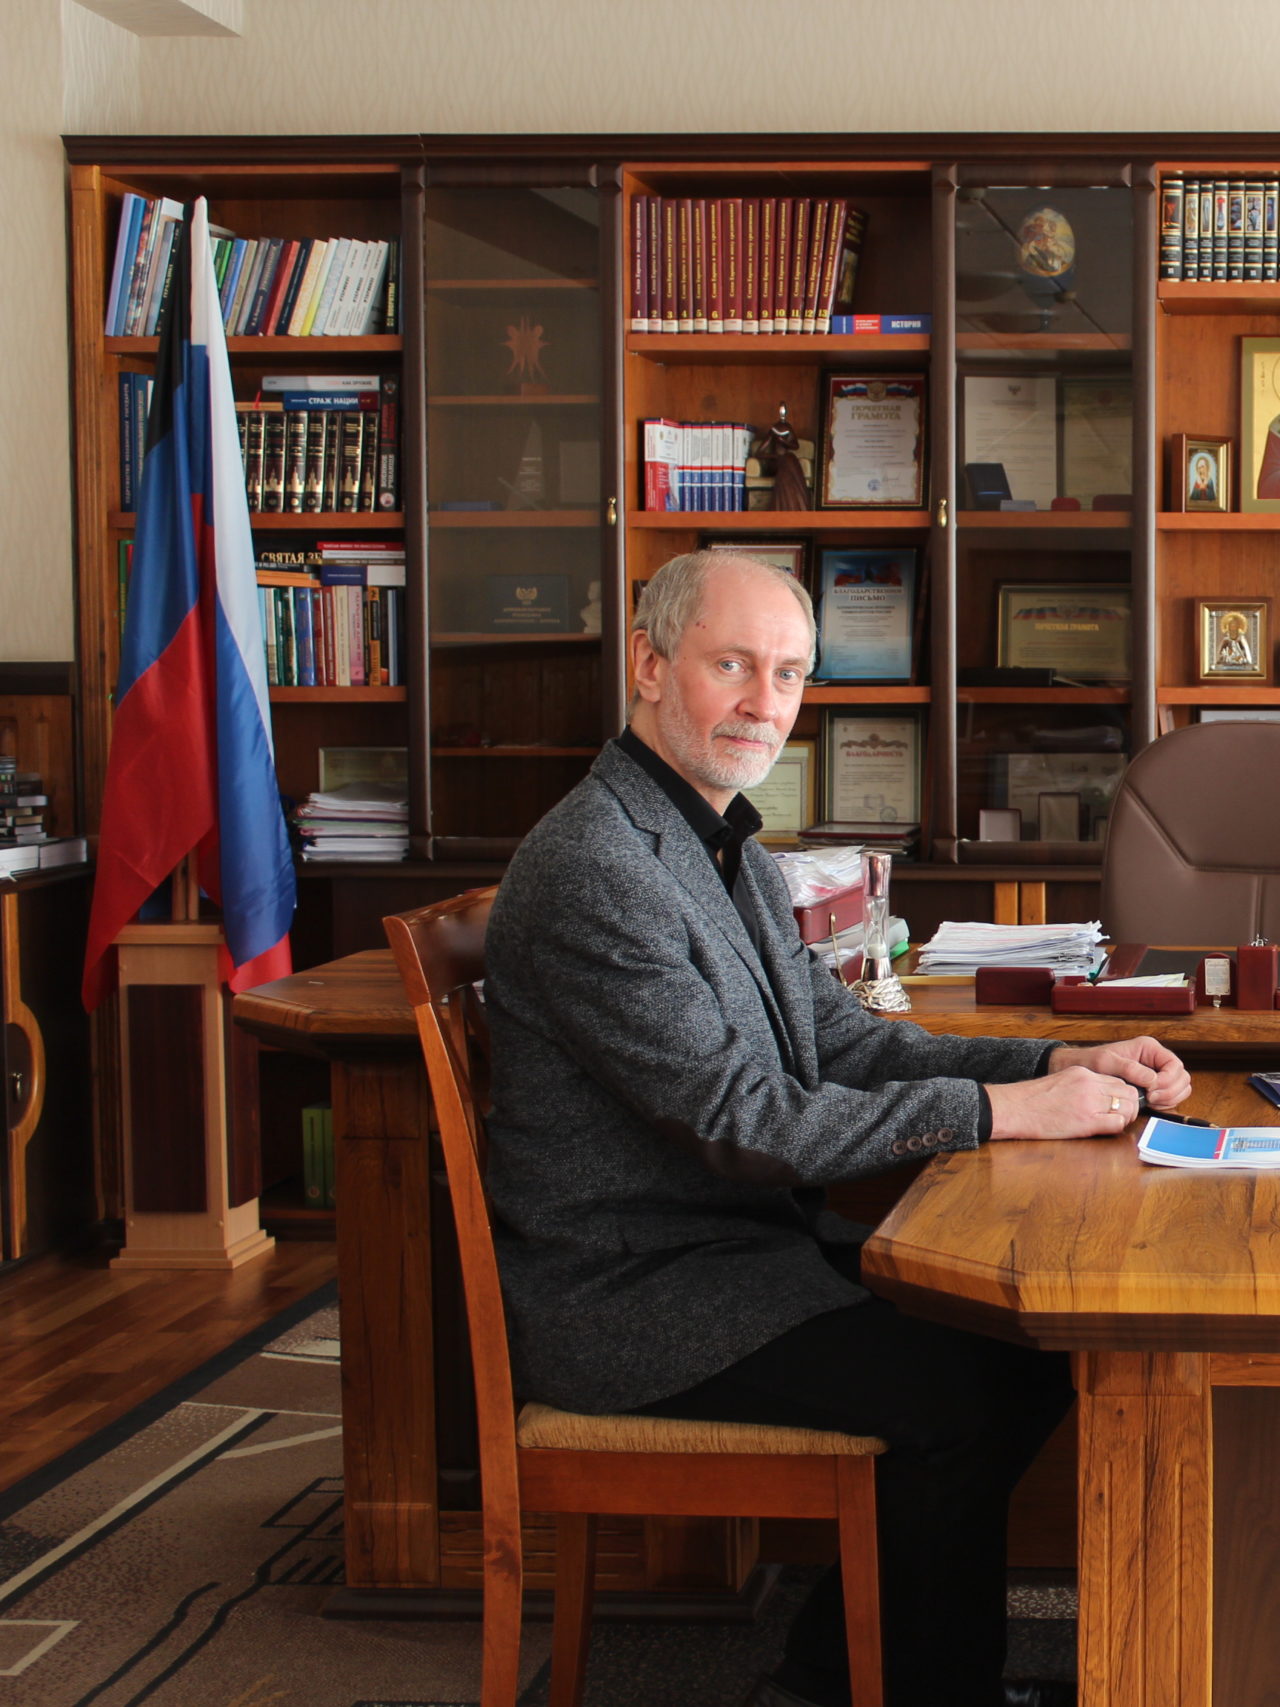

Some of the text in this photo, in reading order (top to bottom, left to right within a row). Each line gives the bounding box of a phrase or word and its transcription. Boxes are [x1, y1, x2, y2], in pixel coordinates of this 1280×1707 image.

[712, 311, 718, 319] 6
[730, 309, 736, 318] 7
[776, 309, 785, 317] 10
[805, 309, 813, 318] 12
[261, 552, 305, 564] СВЯТАЯ
